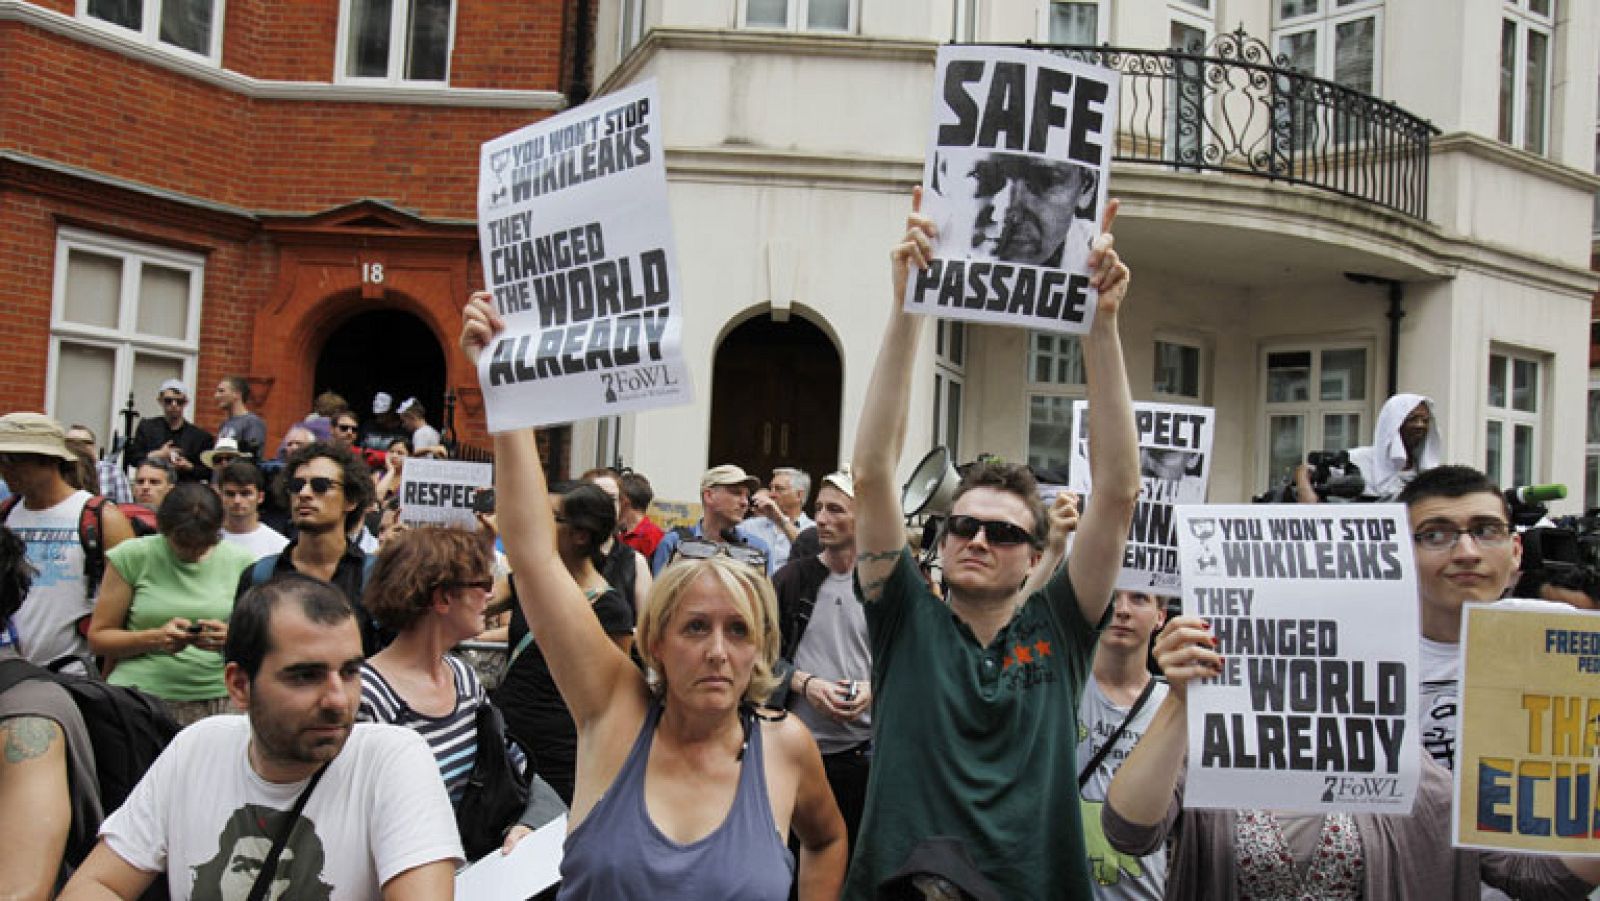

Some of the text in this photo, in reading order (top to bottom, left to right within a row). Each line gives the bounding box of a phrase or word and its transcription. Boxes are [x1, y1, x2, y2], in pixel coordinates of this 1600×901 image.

[512, 98, 649, 167] YOU WON'T STOP
[937, 60, 1109, 166] SAFE
[512, 125, 651, 203] WIKILEAKS
[487, 211, 532, 247] THEY
[490, 222, 604, 285] CHANGED
[362, 263, 384, 284] 18
[494, 248, 669, 328] THE WORLD
[914, 258, 1090, 323] PASSAGE
[490, 307, 669, 386] ALREADY
[405, 481, 475, 508] RESPEC
[1219, 519, 1396, 542] YOU WON'T STOP
[1221, 542, 1402, 580] WIKILEAKS
[1194, 588, 1254, 616] THEY
[1201, 617, 1337, 656] HANGED
[1248, 659, 1406, 715] WORLD
[1202, 713, 1404, 773] ALREADY
[1338, 777, 1403, 797] FoWL
[1477, 757, 1600, 838] ECU
